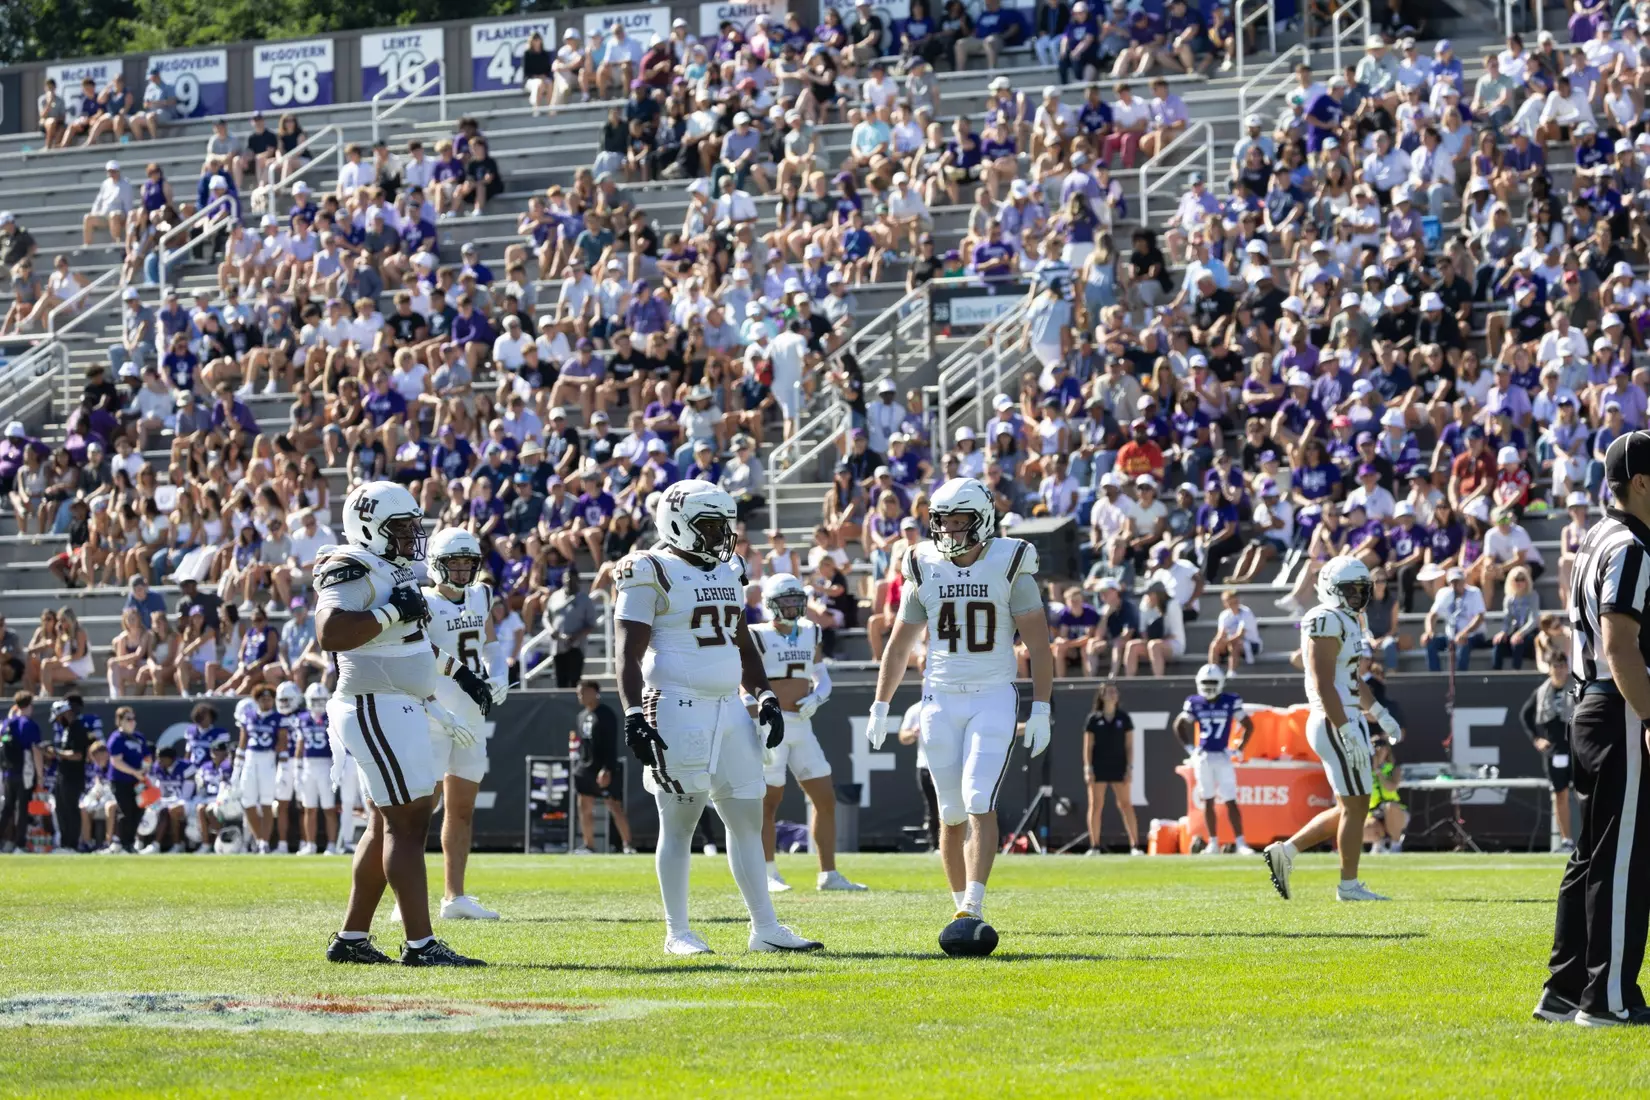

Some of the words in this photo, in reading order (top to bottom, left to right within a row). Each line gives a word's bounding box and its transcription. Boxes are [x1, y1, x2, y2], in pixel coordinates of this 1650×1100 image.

[717, 4, 771, 20] CAHILL
[603, 14, 652, 29] MALOY
[477, 23, 550, 42] FLAHERTY
[382, 35, 422, 50] LENTZ
[379, 50, 426, 94] 16
[269, 60, 319, 106] 58
[175, 73, 200, 116] 9
[694, 587, 737, 602] LEHIGH
[938, 584, 989, 599] LEHIGH
[937, 602, 996, 653] 40
[1310, 616, 1327, 633] 37
[458, 630, 481, 674] 6
[777, 650, 812, 662] LEHIGH
[1199, 718, 1227, 739] 37
